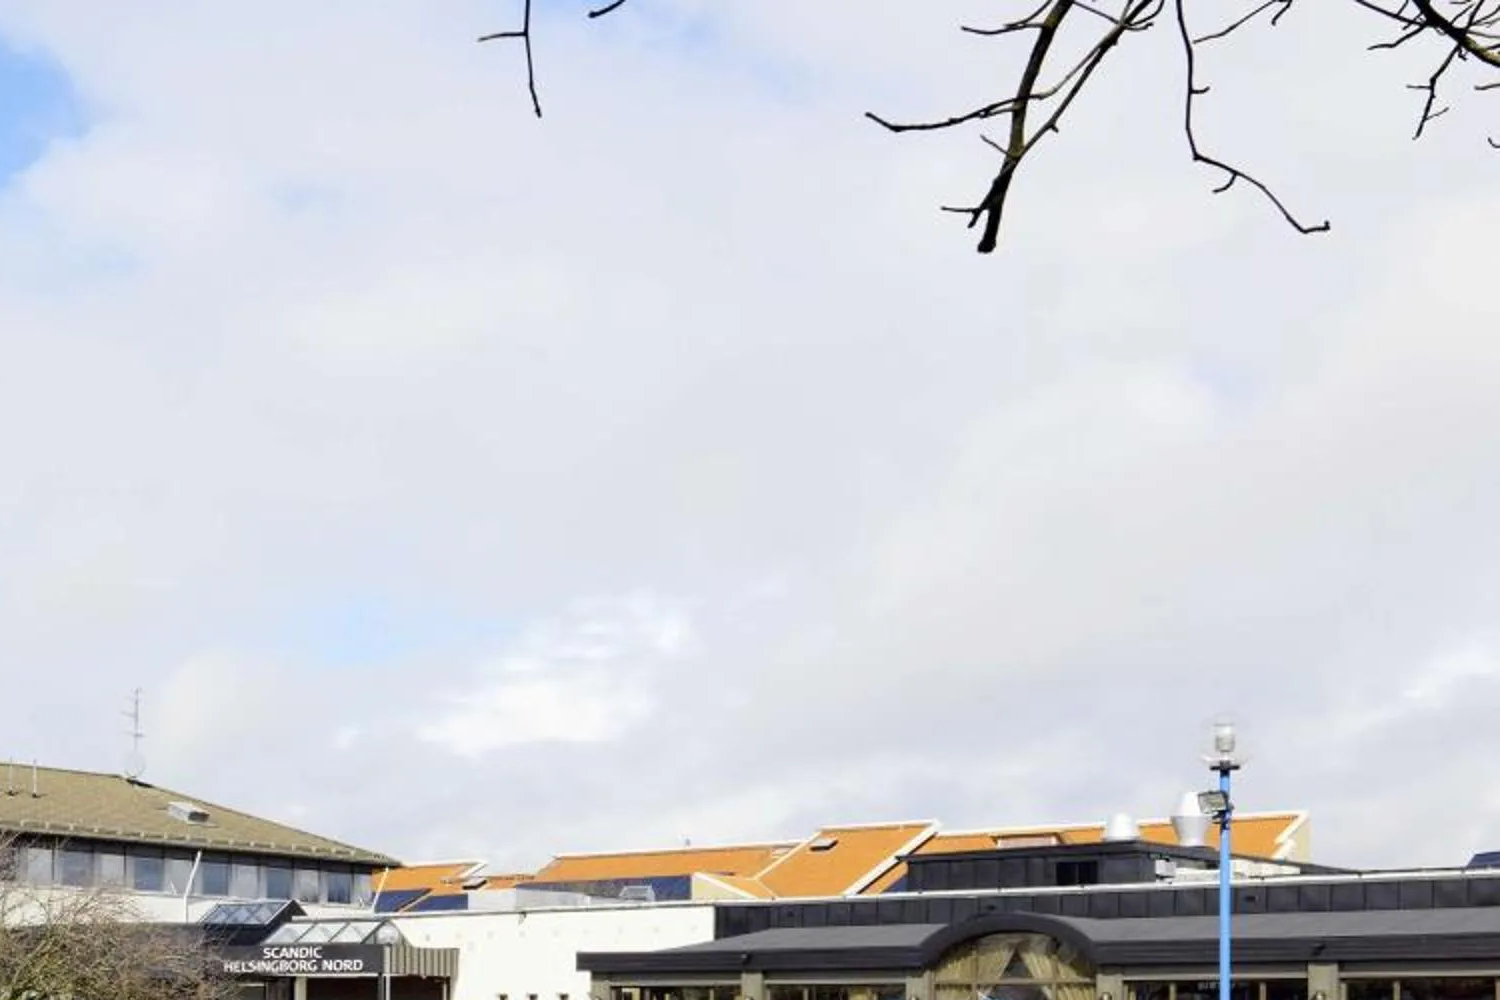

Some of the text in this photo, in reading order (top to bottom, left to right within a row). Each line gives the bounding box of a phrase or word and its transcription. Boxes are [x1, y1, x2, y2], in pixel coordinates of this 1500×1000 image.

[263, 946, 322, 959] SCANDIC
[223, 959, 364, 973] HELSINGBORG NORD
